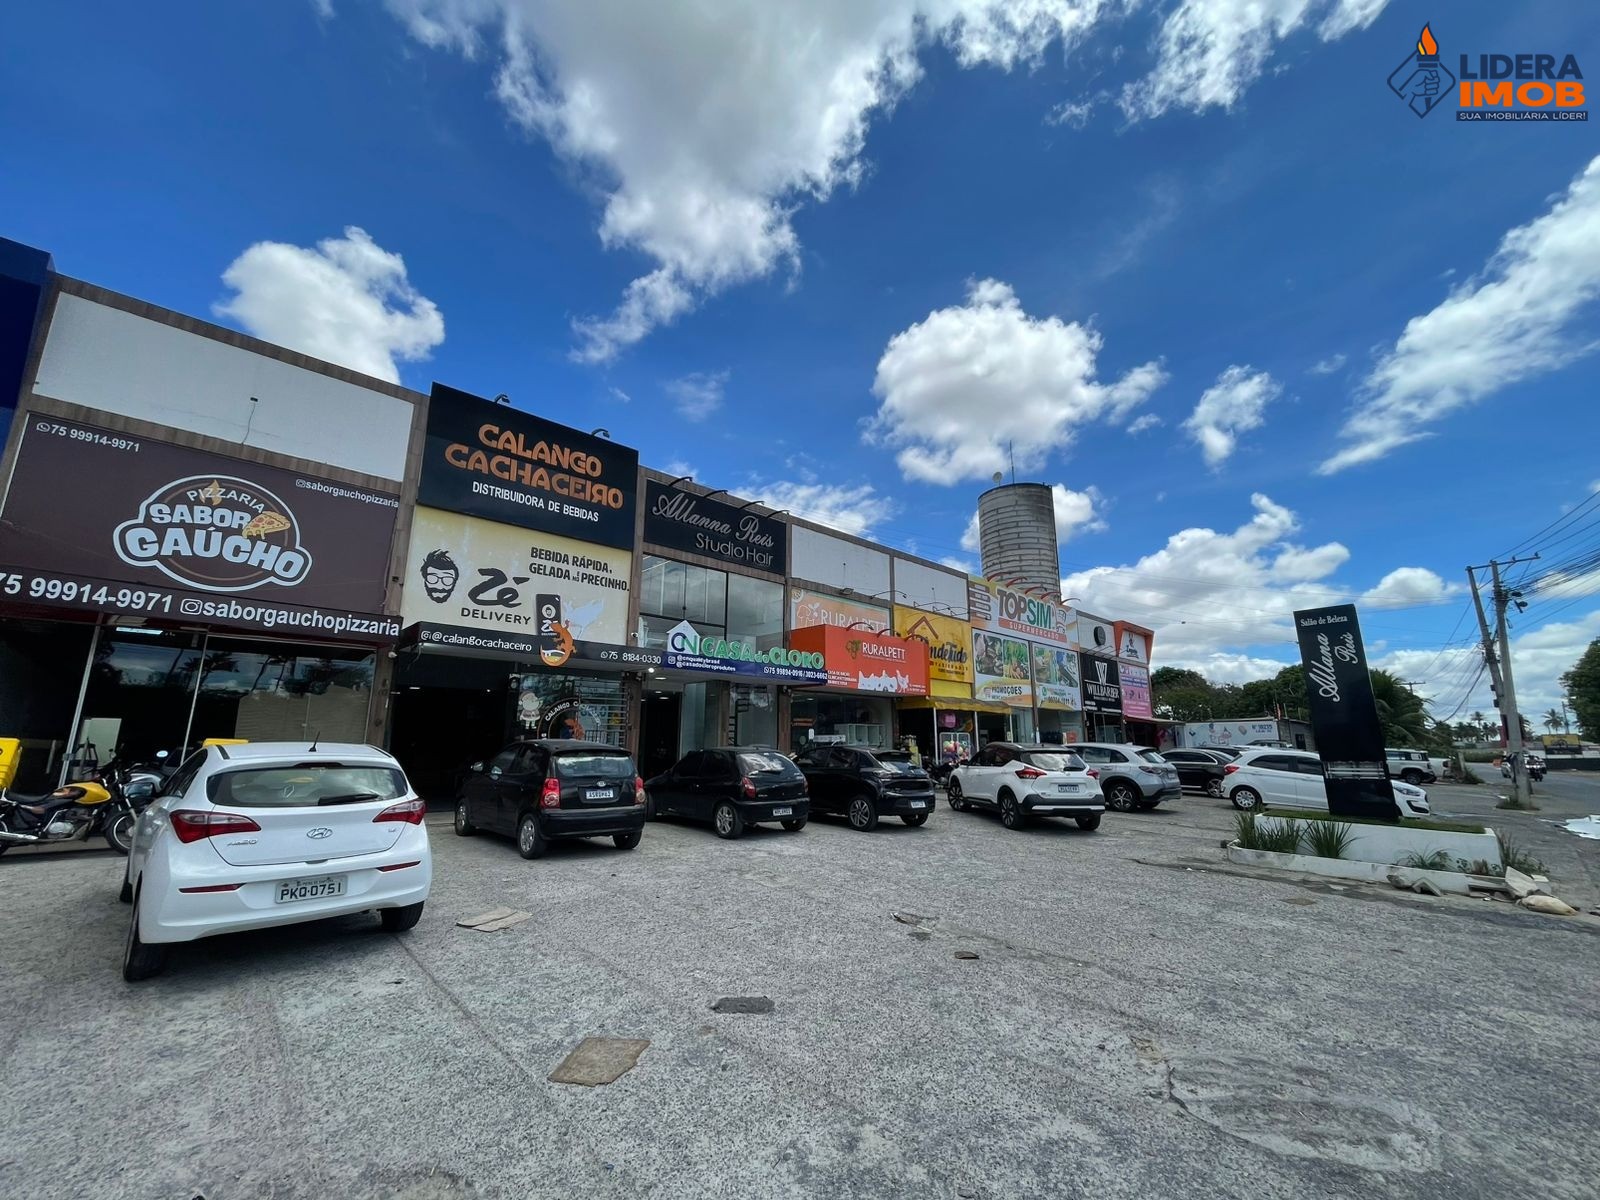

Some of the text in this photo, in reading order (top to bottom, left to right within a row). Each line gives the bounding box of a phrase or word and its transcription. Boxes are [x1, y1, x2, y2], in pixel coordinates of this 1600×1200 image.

[51, 424, 140, 452] 75 99914-9971
[478, 423, 603, 478] CALANGO
[445, 443, 624, 509] CACHACEIRO
[186, 486, 265, 513] PIZZARIA
[472, 481, 599, 522] DISTRIBUIDORA DE BEBIDAS
[150, 503, 251, 530] SABOR
[735, 515, 774, 548] Reis
[125, 521, 307, 580] GAÚCHO
[530, 547, 613, 575] BEBIDA RÁPIDA,
[695, 532, 774, 567] Studio Hair
[468, 567, 531, 609] Zé
[529, 562, 571, 581] GELADA
[581, 572, 630, 592] PRECINHO.
[29, 576, 173, 613] 99914-9971
[203, 602, 400, 637] saborgauchopizzaria
[461, 607, 532, 626] DELIVERY
[1300, 615, 1348, 627] Salão de Beleza
[1008, 620, 1060, 641] SUPERMERCADO
[608, 650, 662, 665] 75 8184-0330
[701, 637, 756, 662] CASA
[755, 651, 770, 664] do
[769, 646, 825, 670] CLORO
[862, 642, 906, 660] RURALPETT
[1334, 631, 1359, 664] Reis
[768, 667, 776, 675] 75
[545, 701, 570, 721] CALANGO
